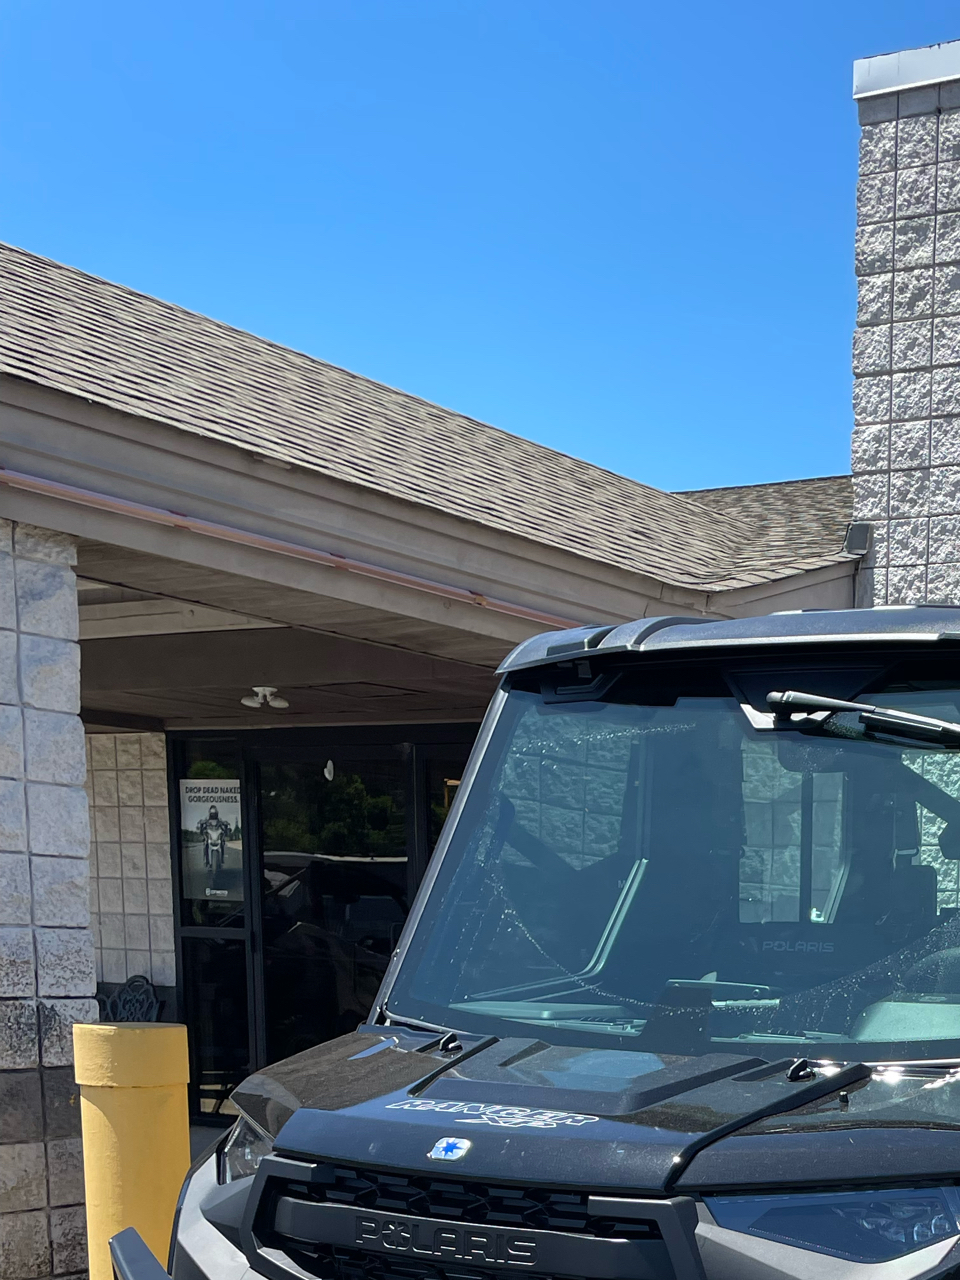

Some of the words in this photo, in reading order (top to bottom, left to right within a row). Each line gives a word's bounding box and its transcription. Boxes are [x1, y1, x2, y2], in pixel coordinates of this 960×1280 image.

[185, 786, 202, 794] DROP
[202, 786, 219, 794] DEAD
[220, 786, 240, 795] NAKED
[188, 795, 240, 804] GORGEOUSNESS.
[762, 941, 834, 953] POLARIS
[385, 1099, 600, 1126] RANGER
[454, 1114, 557, 1129] XP
[356, 1216, 539, 1267] POLARIS
